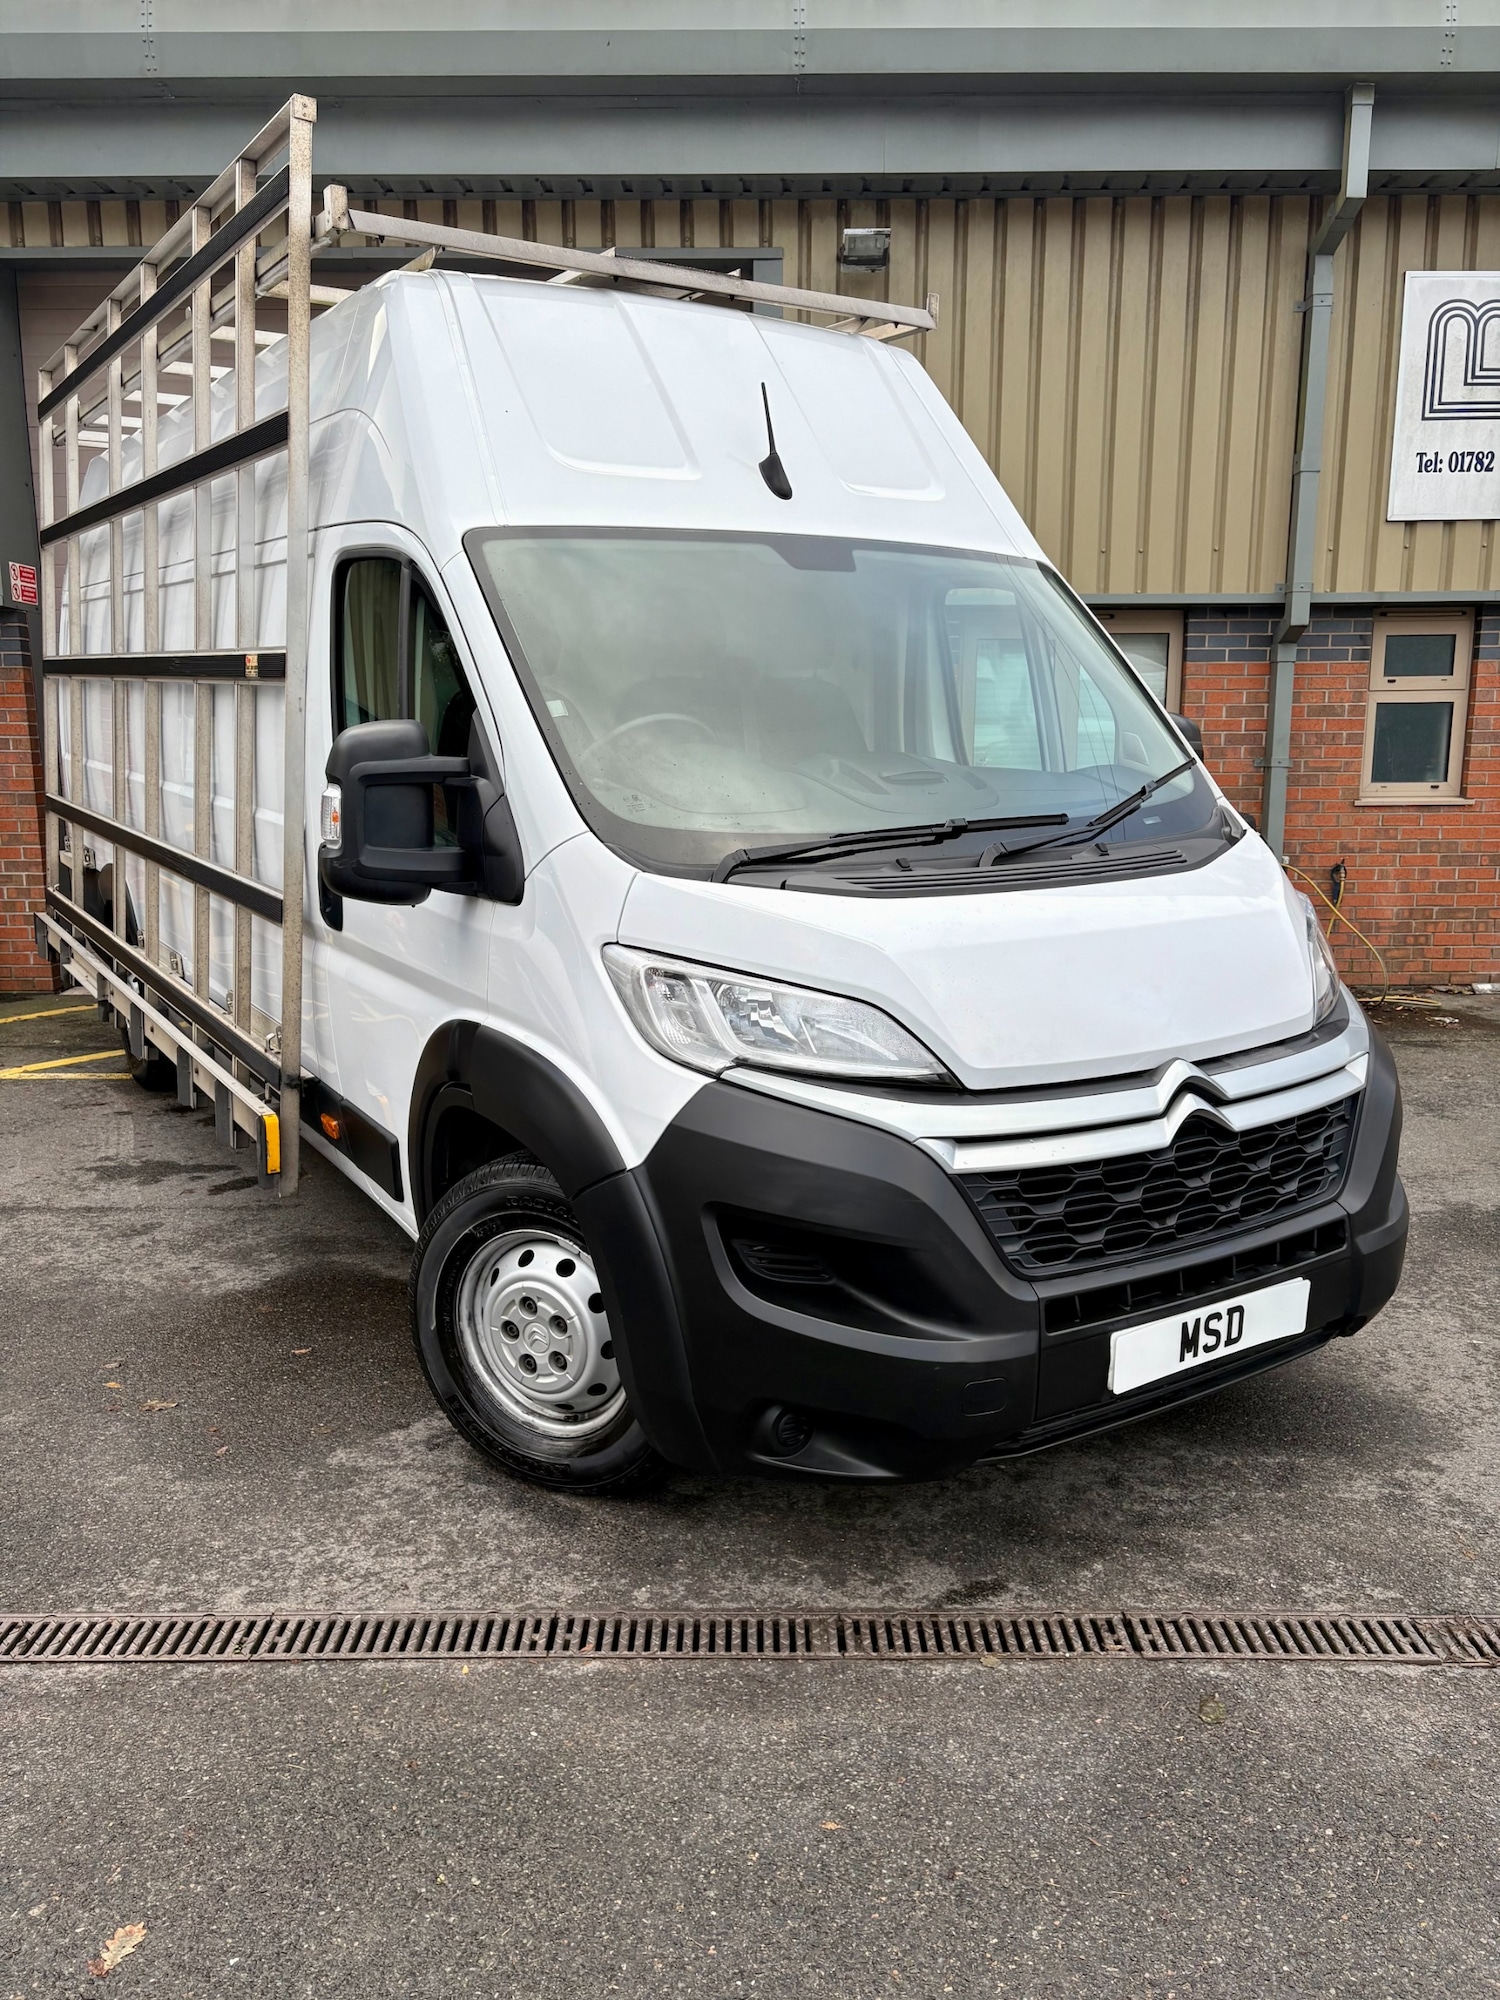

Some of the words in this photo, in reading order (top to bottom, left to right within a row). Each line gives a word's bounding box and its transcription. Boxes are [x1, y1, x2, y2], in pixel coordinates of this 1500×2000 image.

[1416, 451, 1443, 474] Tel:
[1448, 451, 1495, 473] 01782
[1179, 1304, 1245, 1363] MSD
